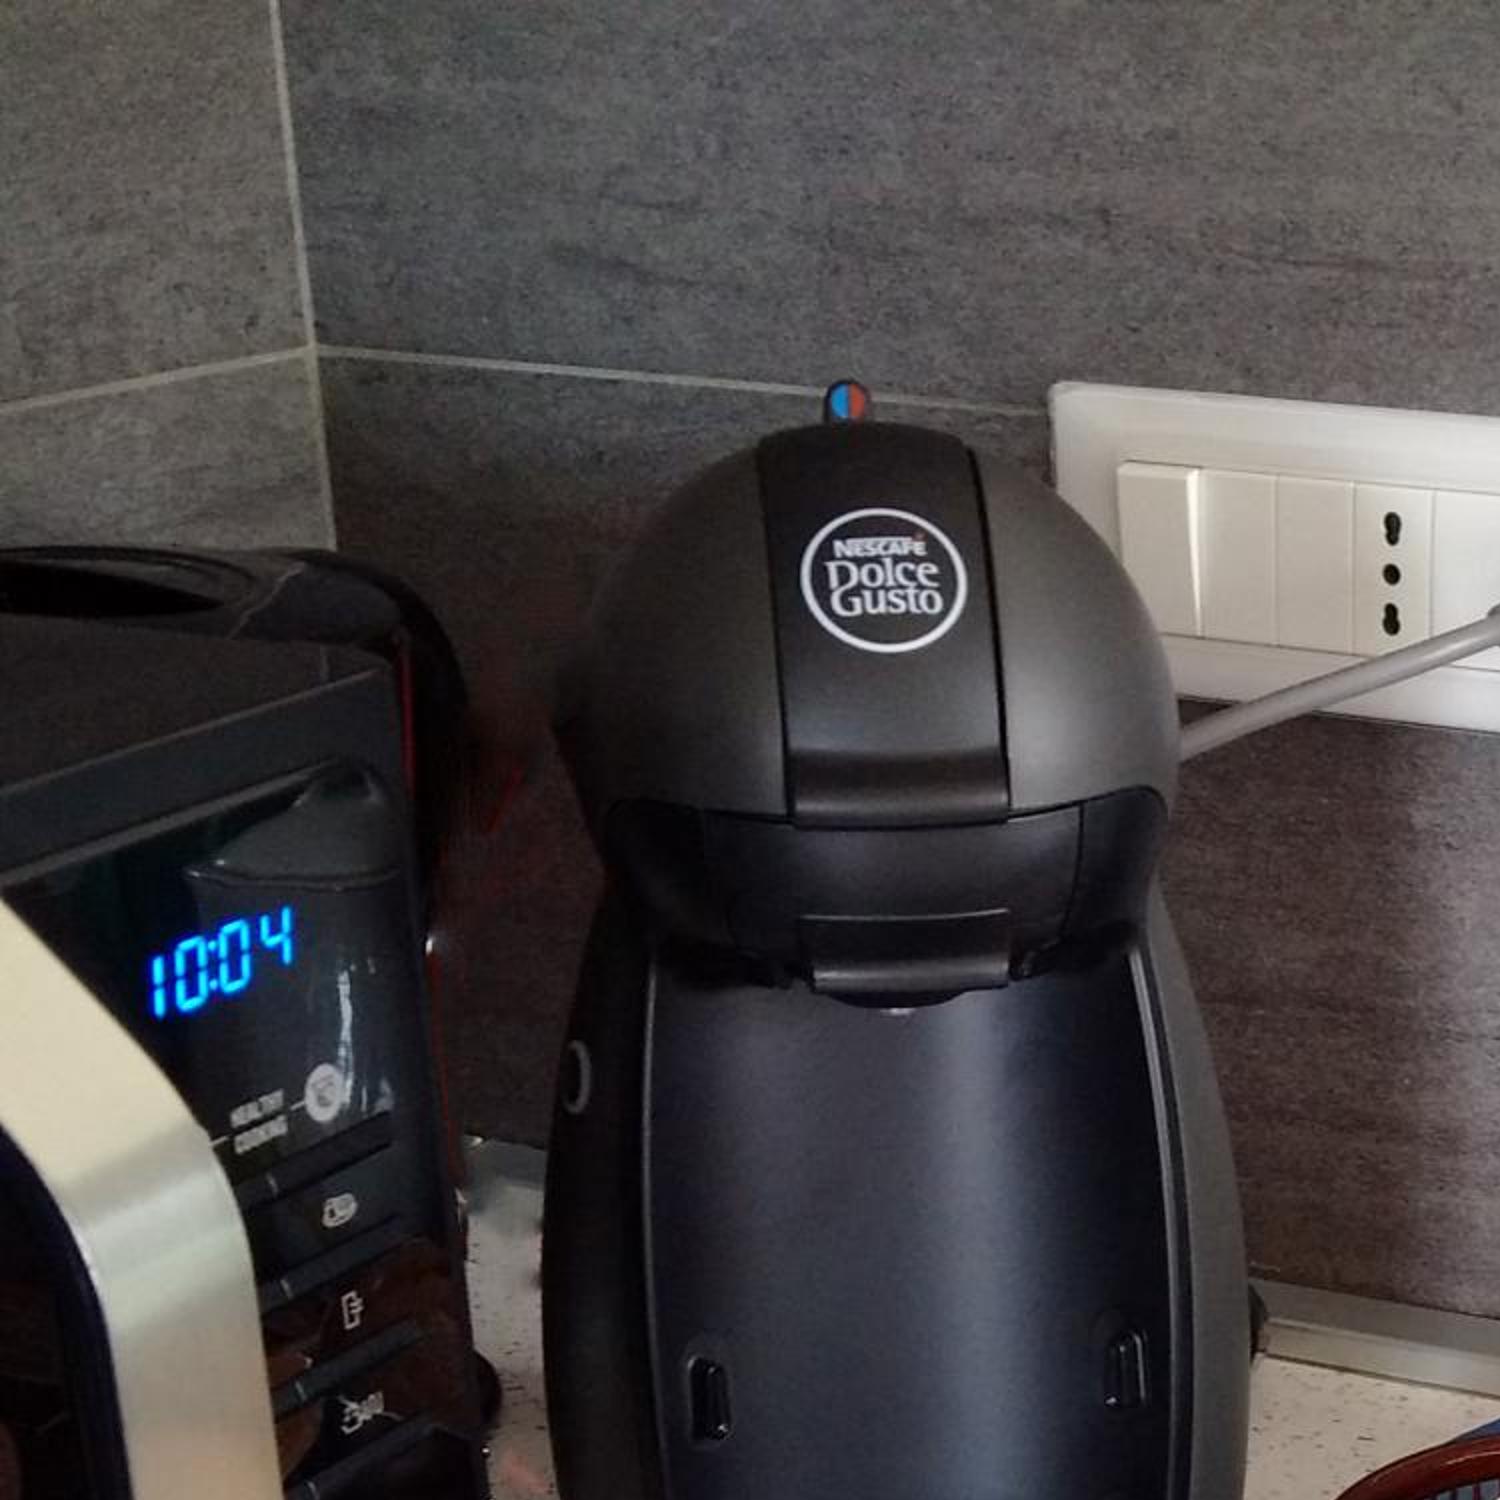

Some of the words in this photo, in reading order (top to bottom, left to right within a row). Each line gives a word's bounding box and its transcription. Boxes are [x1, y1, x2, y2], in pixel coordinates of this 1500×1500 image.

[823, 557, 941, 591] Dolce
[829, 583, 944, 618] Gusto
[151, 905, 293, 1020] 10:04
